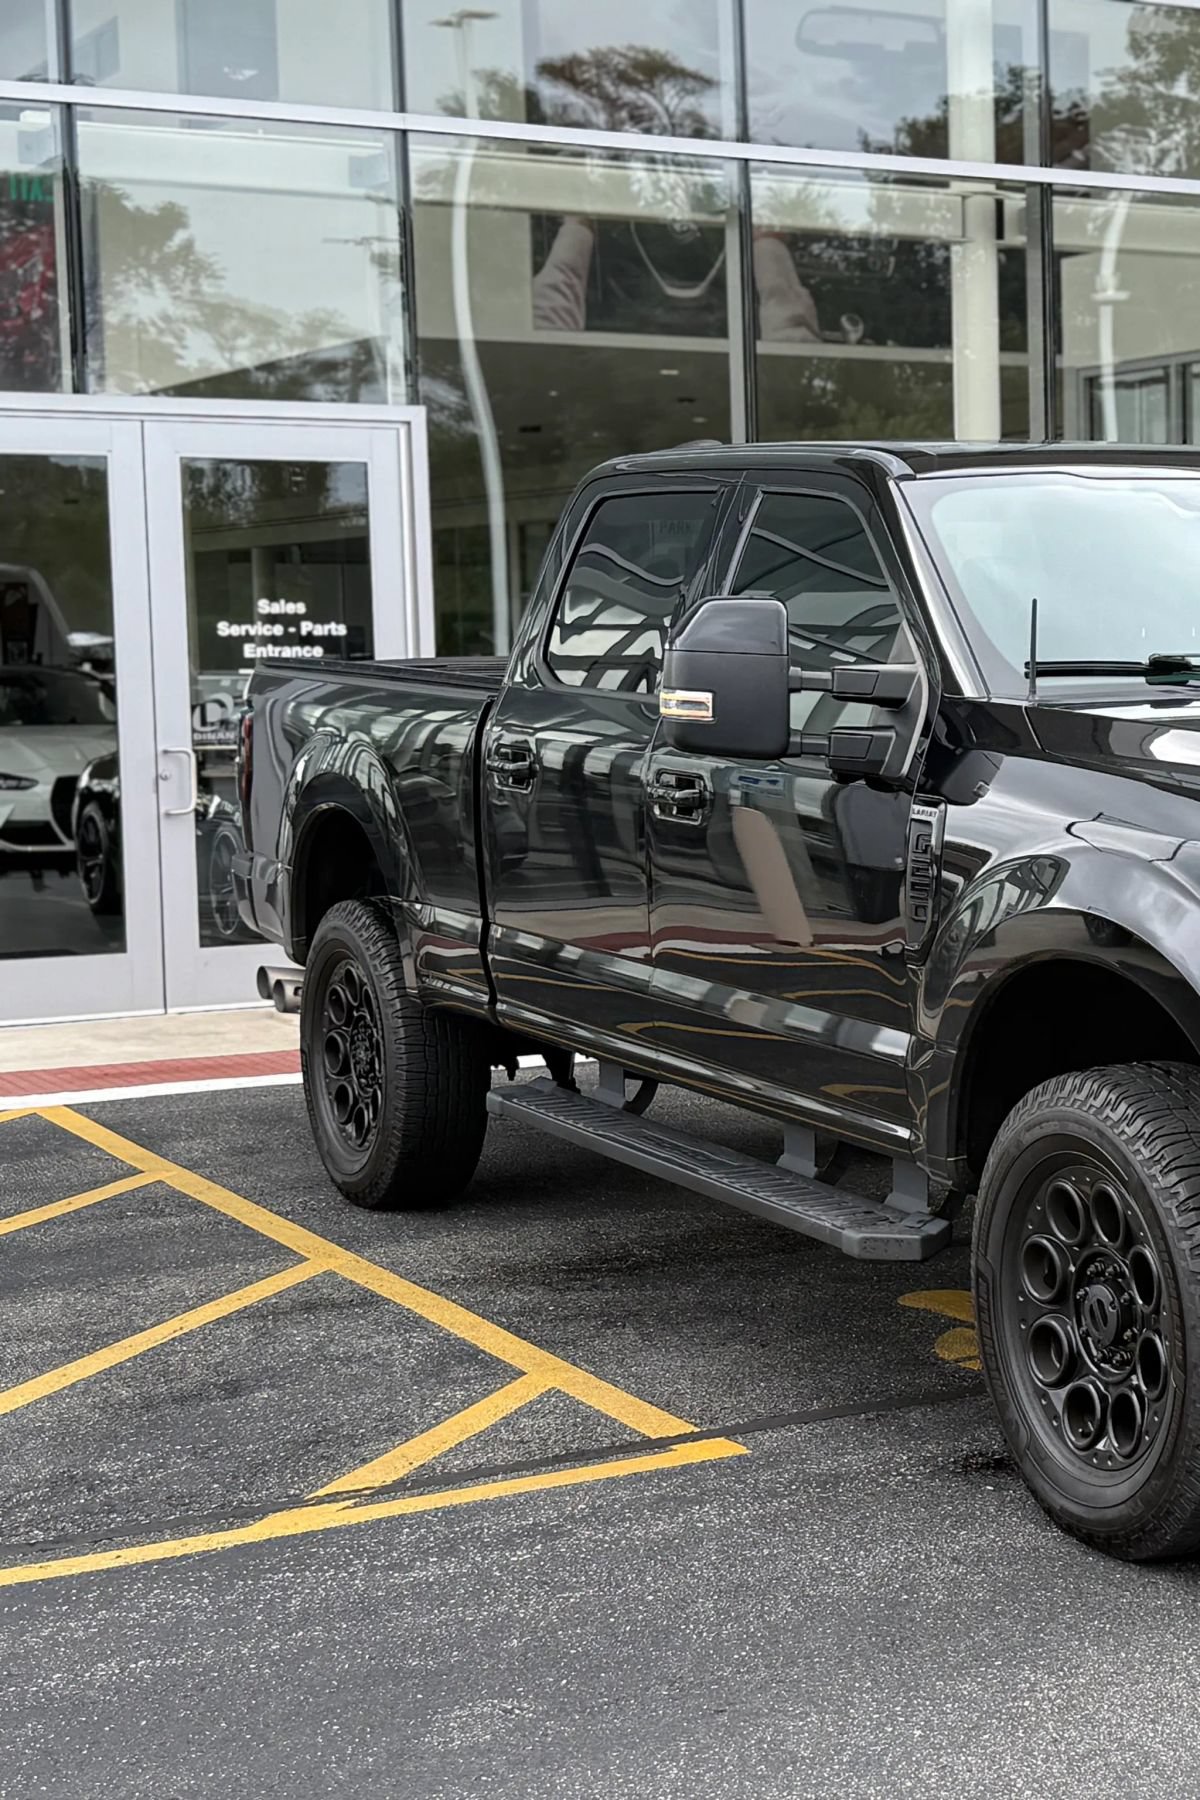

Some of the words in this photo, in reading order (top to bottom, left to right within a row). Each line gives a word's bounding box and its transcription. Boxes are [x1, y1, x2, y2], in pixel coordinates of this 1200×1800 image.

[257, 598, 307, 614] Sales
[217, 621, 284, 637] Service
[300, 621, 348, 637] Parts
[243, 643, 324, 658] Entrance
[193, 732, 235, 741] DINAN
[912, 808, 938, 818] LARIAT
